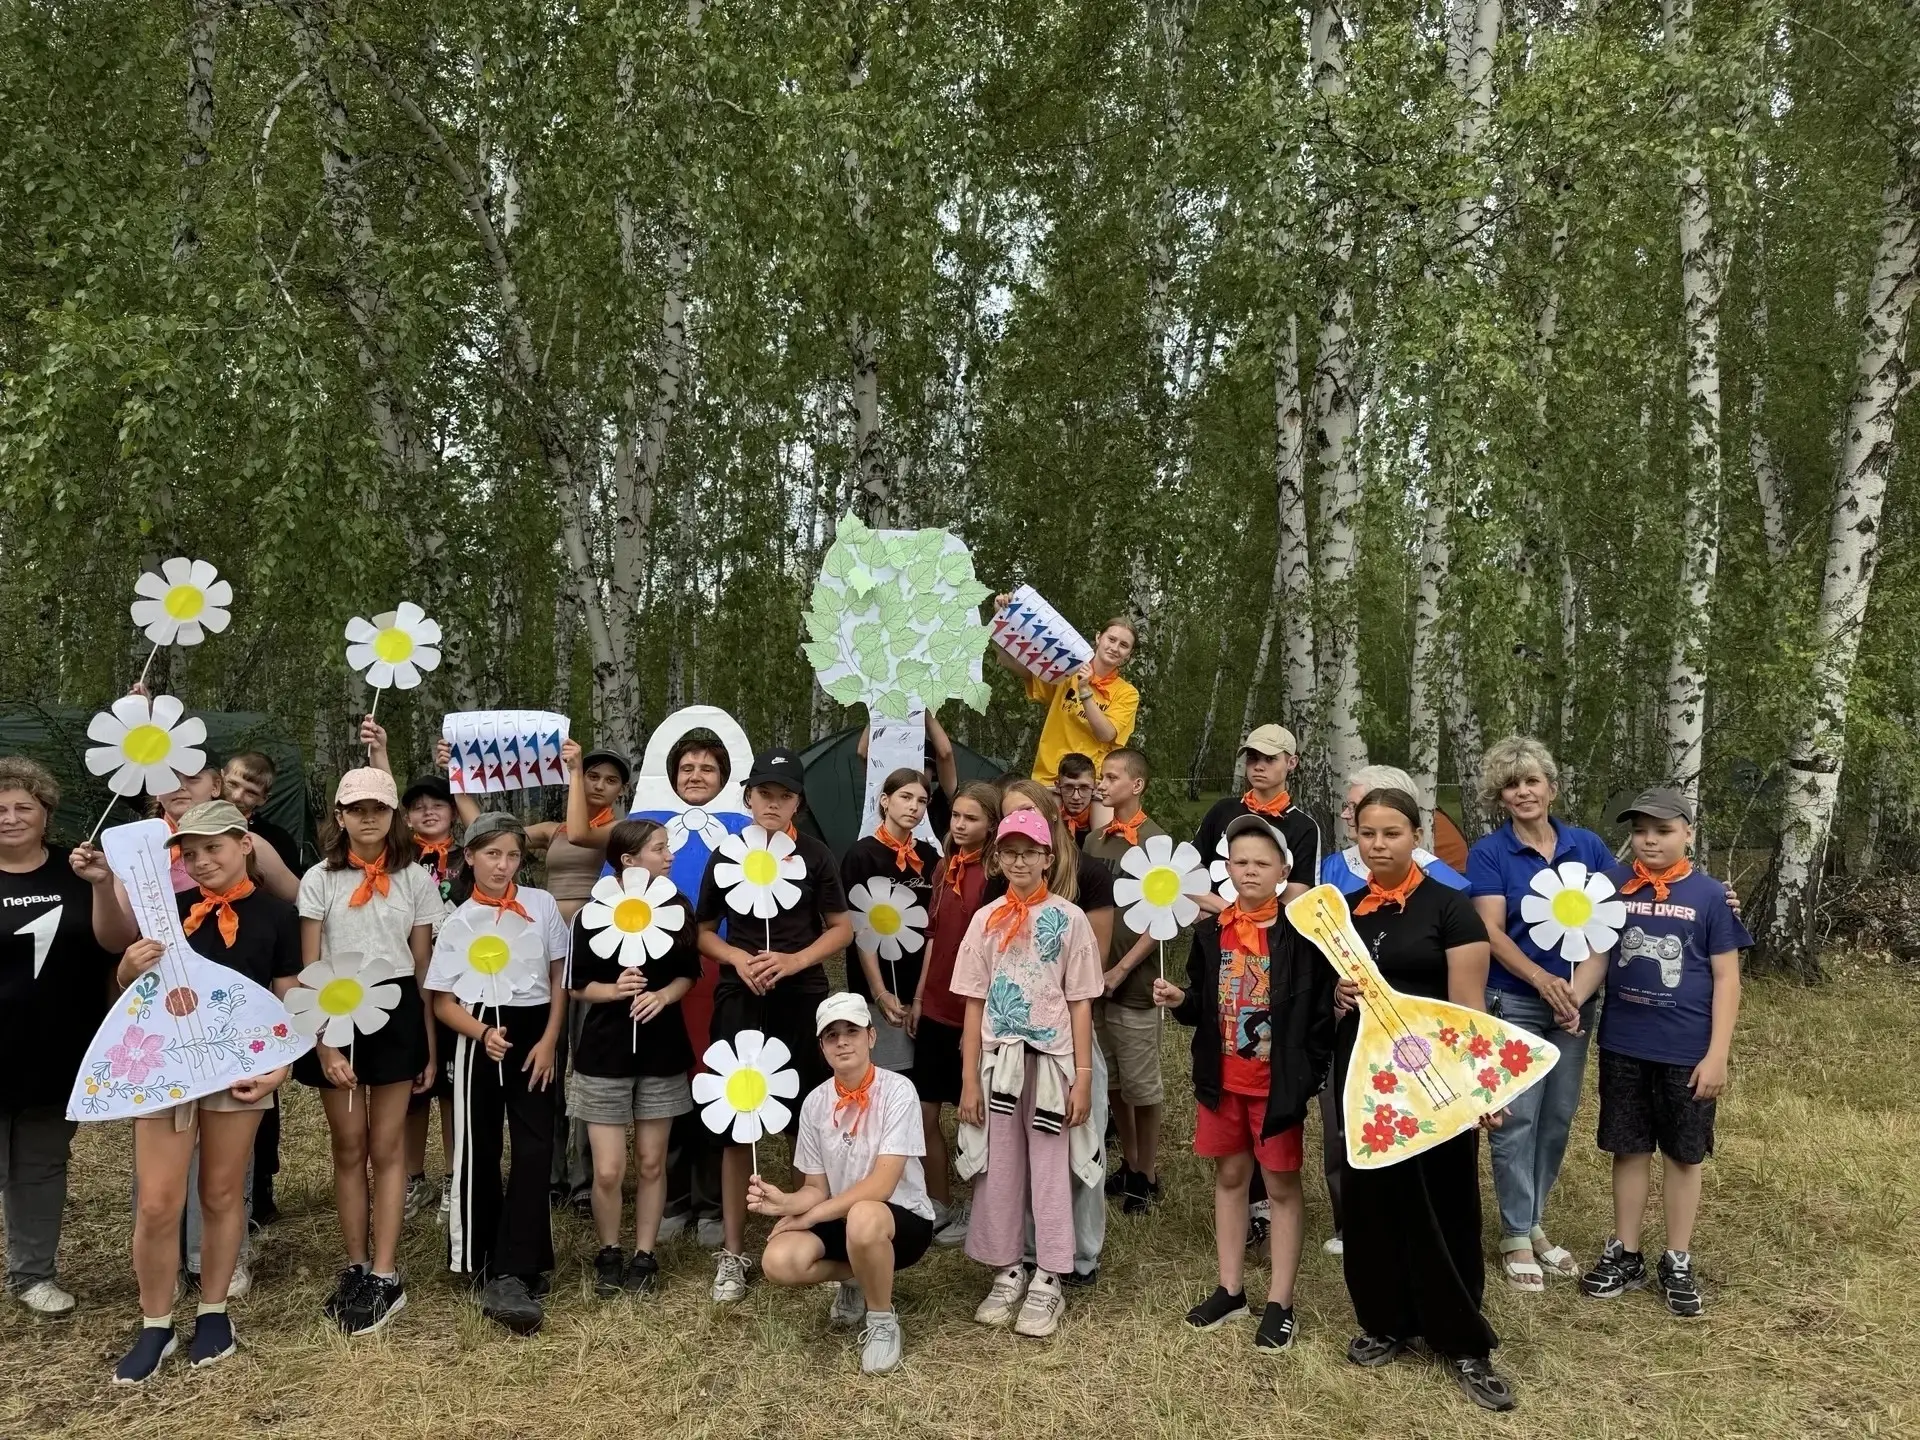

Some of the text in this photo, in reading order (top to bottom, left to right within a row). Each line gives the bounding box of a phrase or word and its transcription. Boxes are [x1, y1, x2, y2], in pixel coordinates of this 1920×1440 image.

[3, 895, 62, 907] Первые
[1624, 901, 1697, 921] AME OVER
